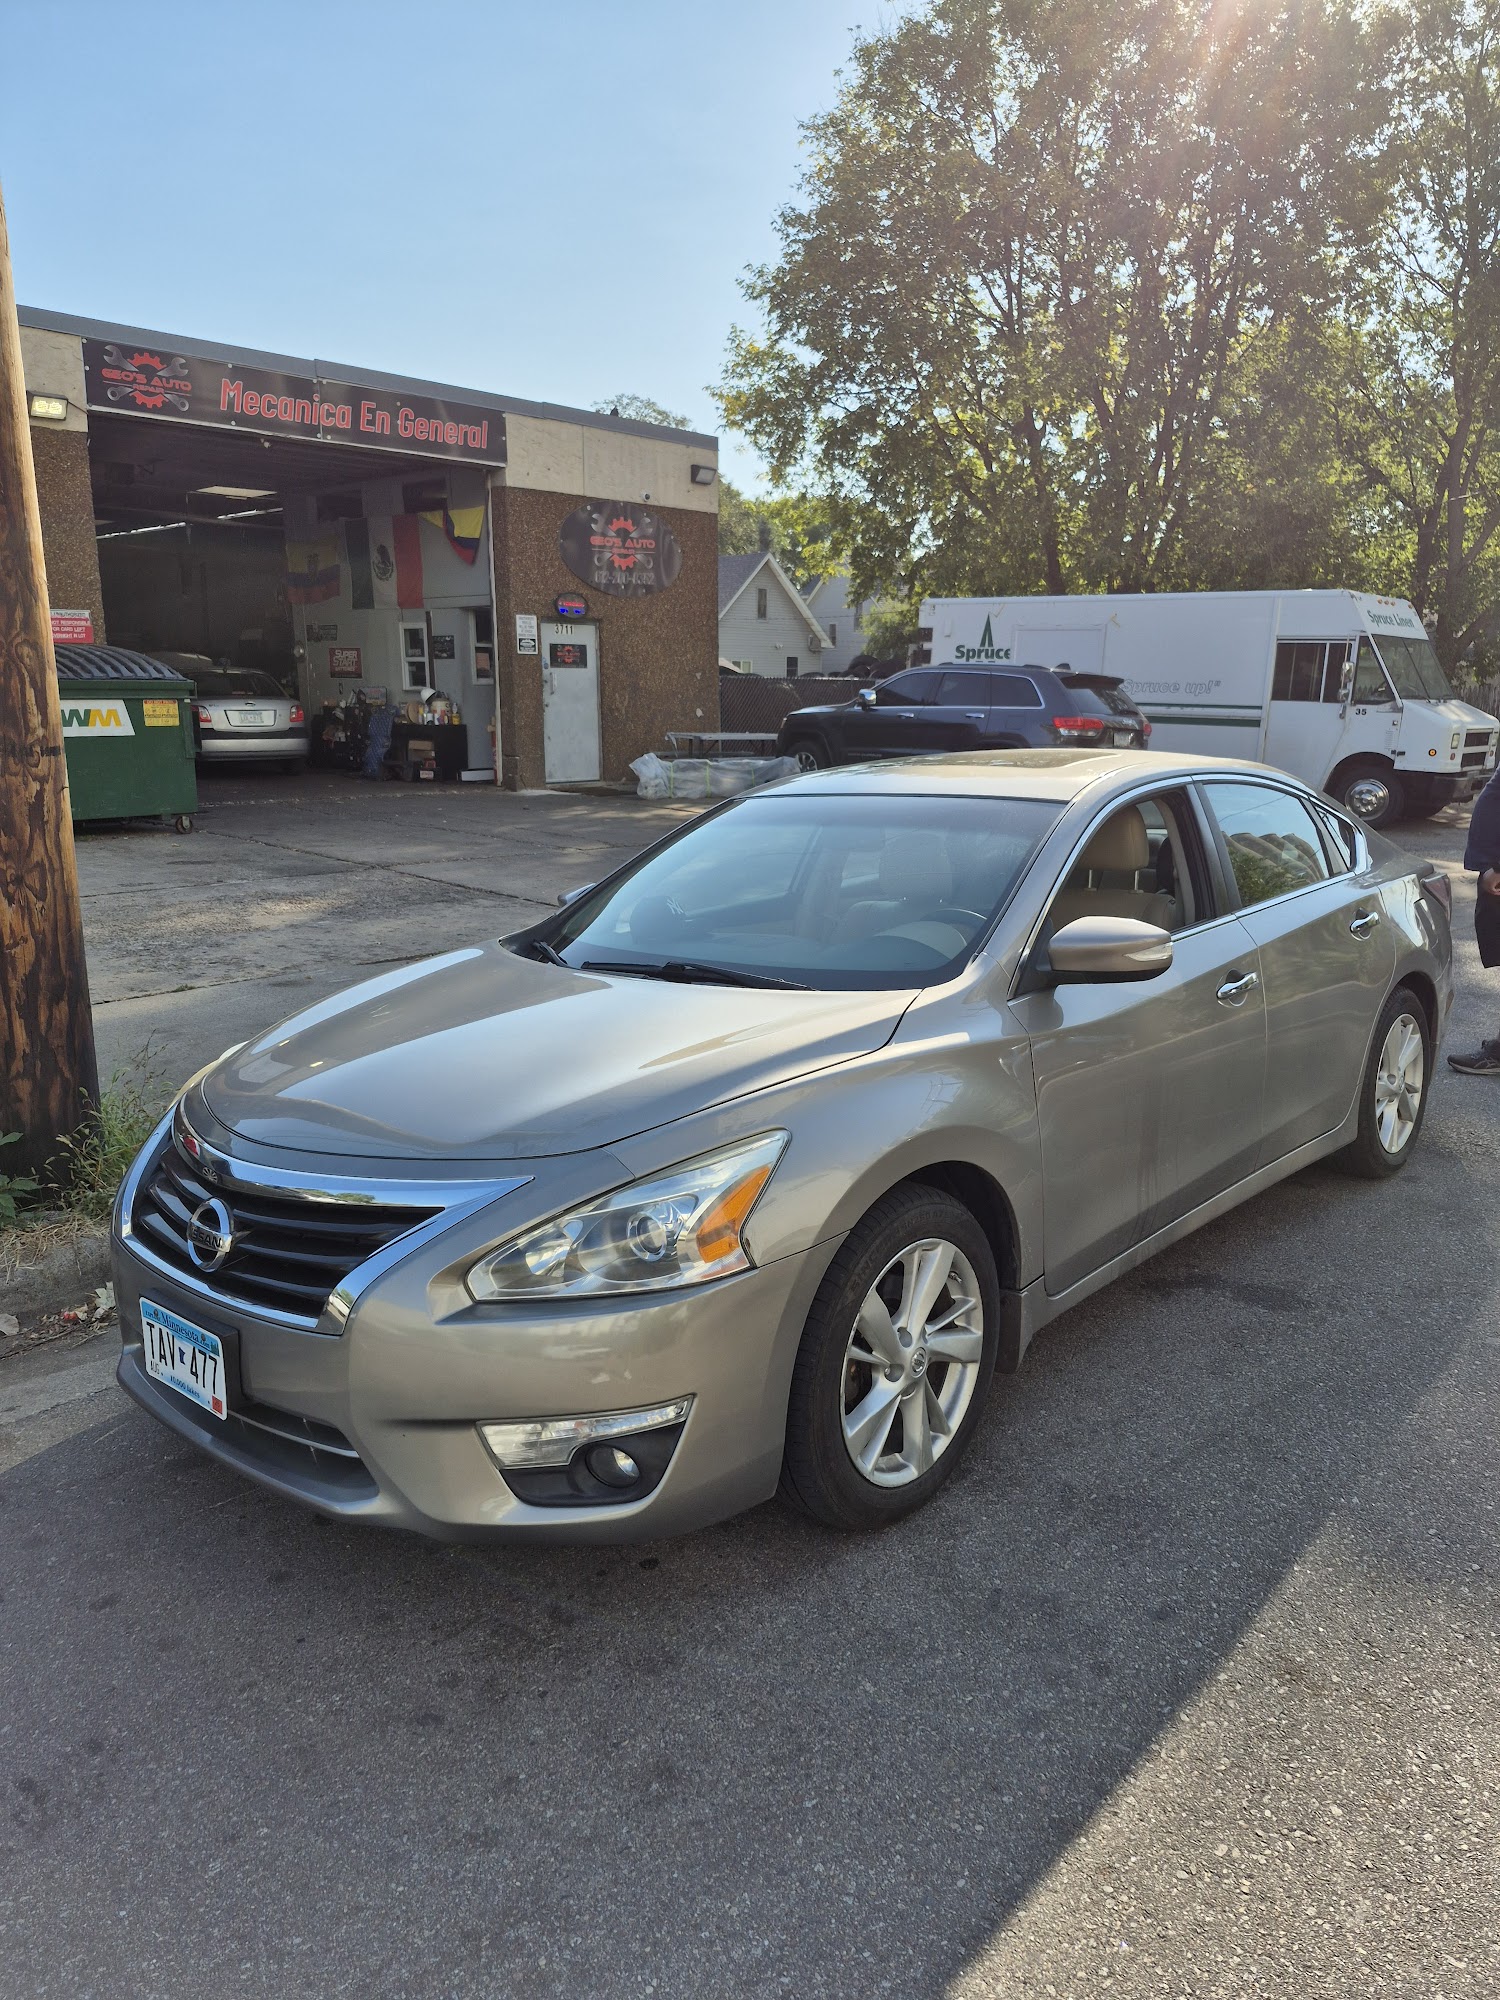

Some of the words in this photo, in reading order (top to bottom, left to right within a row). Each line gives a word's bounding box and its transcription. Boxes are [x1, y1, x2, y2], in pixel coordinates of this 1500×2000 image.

[150, 376, 192, 391] AUTO
[220, 378, 352, 429] Mecanica
[360, 401, 391, 434] En
[399, 408, 489, 449] General
[624, 538, 656, 549] AUTO
[1366, 610, 1395, 628] Spruce
[554, 623, 574, 635] 3711
[334, 649, 358, 659] SUPER
[955, 644, 1011, 662] Spruce
[332, 656, 357, 667] START
[1122, 679, 1180, 695] Spruce
[61, 709, 122, 727] WM
[1355, 708, 1367, 716] 35
[161, 1311, 200, 1341] Minnesota
[146, 1321, 175, 1371] TAV
[190, 1346, 217, 1395] 477
